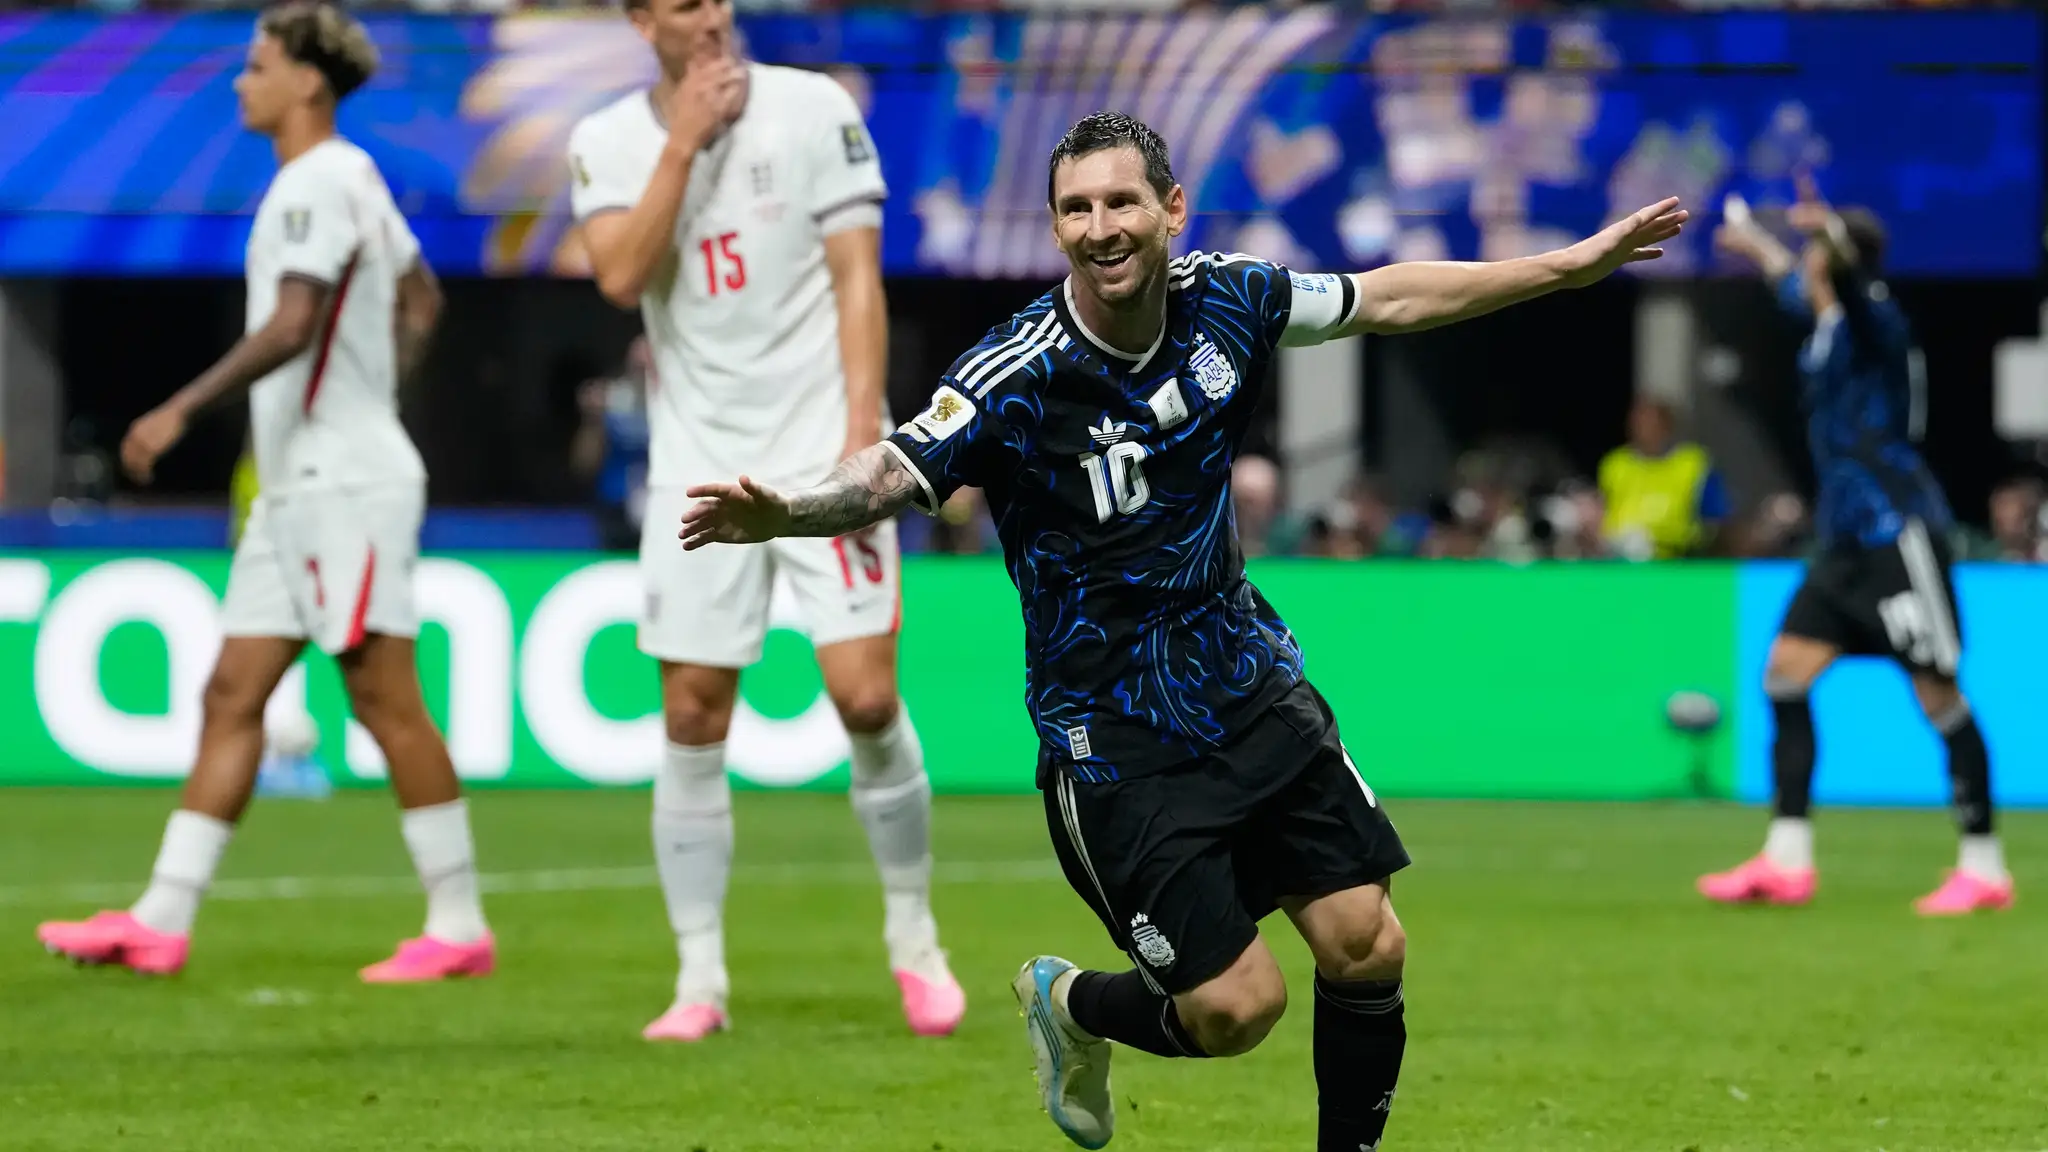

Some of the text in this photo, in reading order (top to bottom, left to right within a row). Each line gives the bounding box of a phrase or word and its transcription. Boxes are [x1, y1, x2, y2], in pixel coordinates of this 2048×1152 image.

[700, 230, 746, 296] 15
[1078, 441, 1150, 524] 10
[831, 526, 883, 589] 15
